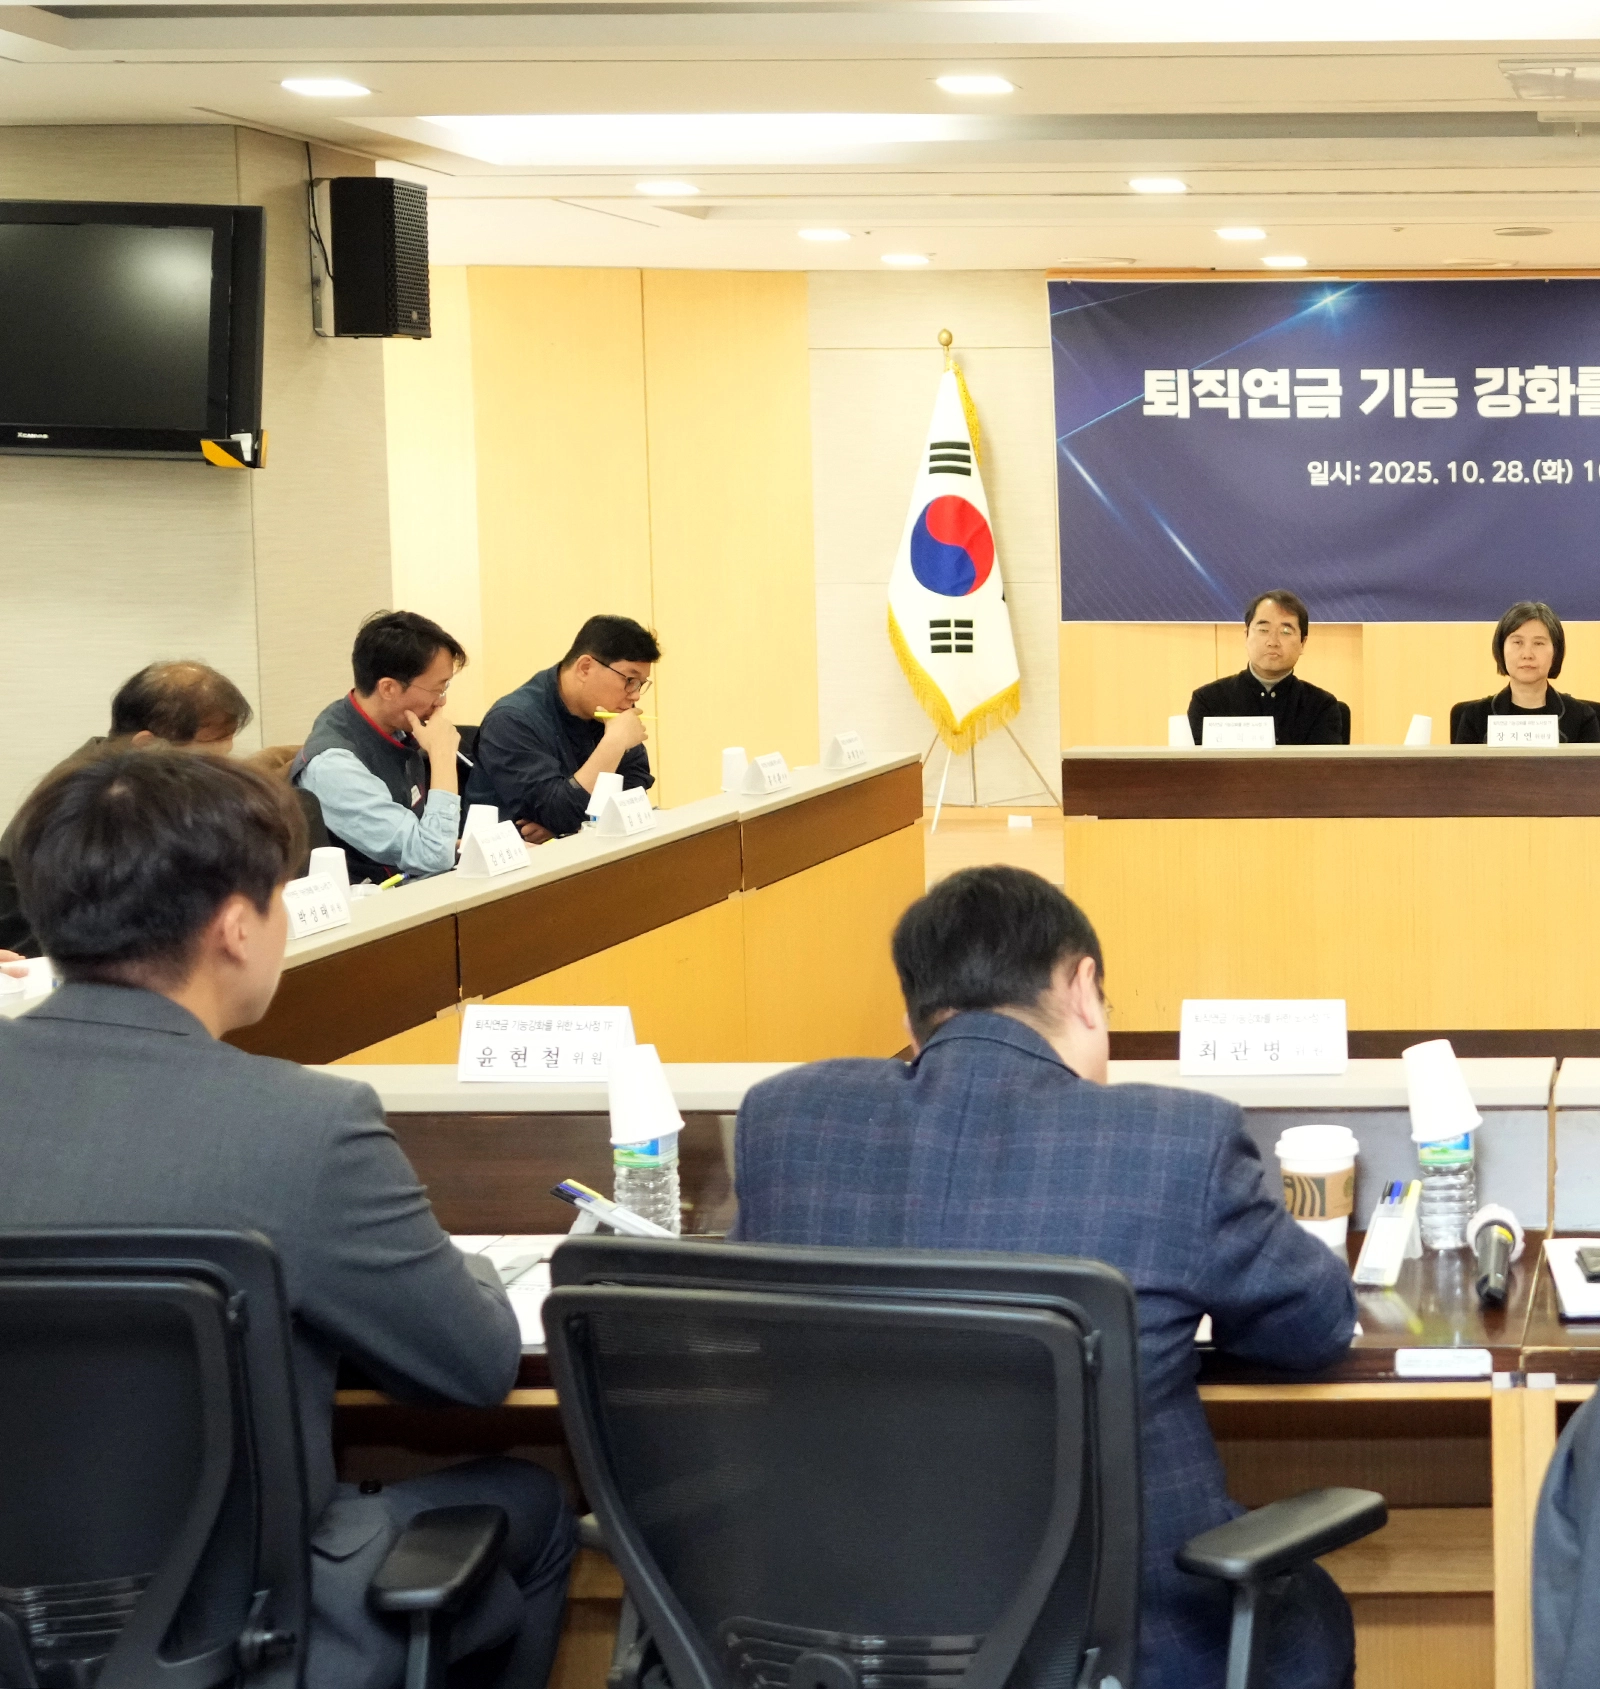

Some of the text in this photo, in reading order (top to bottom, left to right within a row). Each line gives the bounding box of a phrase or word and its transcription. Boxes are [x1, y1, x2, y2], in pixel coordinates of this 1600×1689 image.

[1142, 367, 1344, 420] 퇴직연금
[1358, 368, 1460, 419] 기능
[1306, 460, 1361, 487] 일시:
[1368, 461, 1439, 485] 2025.
[1447, 461, 1485, 484] 10.
[1491, 458, 1574, 485] 28.(화)
[475, 1019, 509, 1031] 퇴직연금
[511, 1019, 553, 1032] 기능강화를
[555, 1019, 573, 1031] 위한
[575, 1019, 601, 1032] 노사정
[475, 1045, 560, 1069] 윤현철
